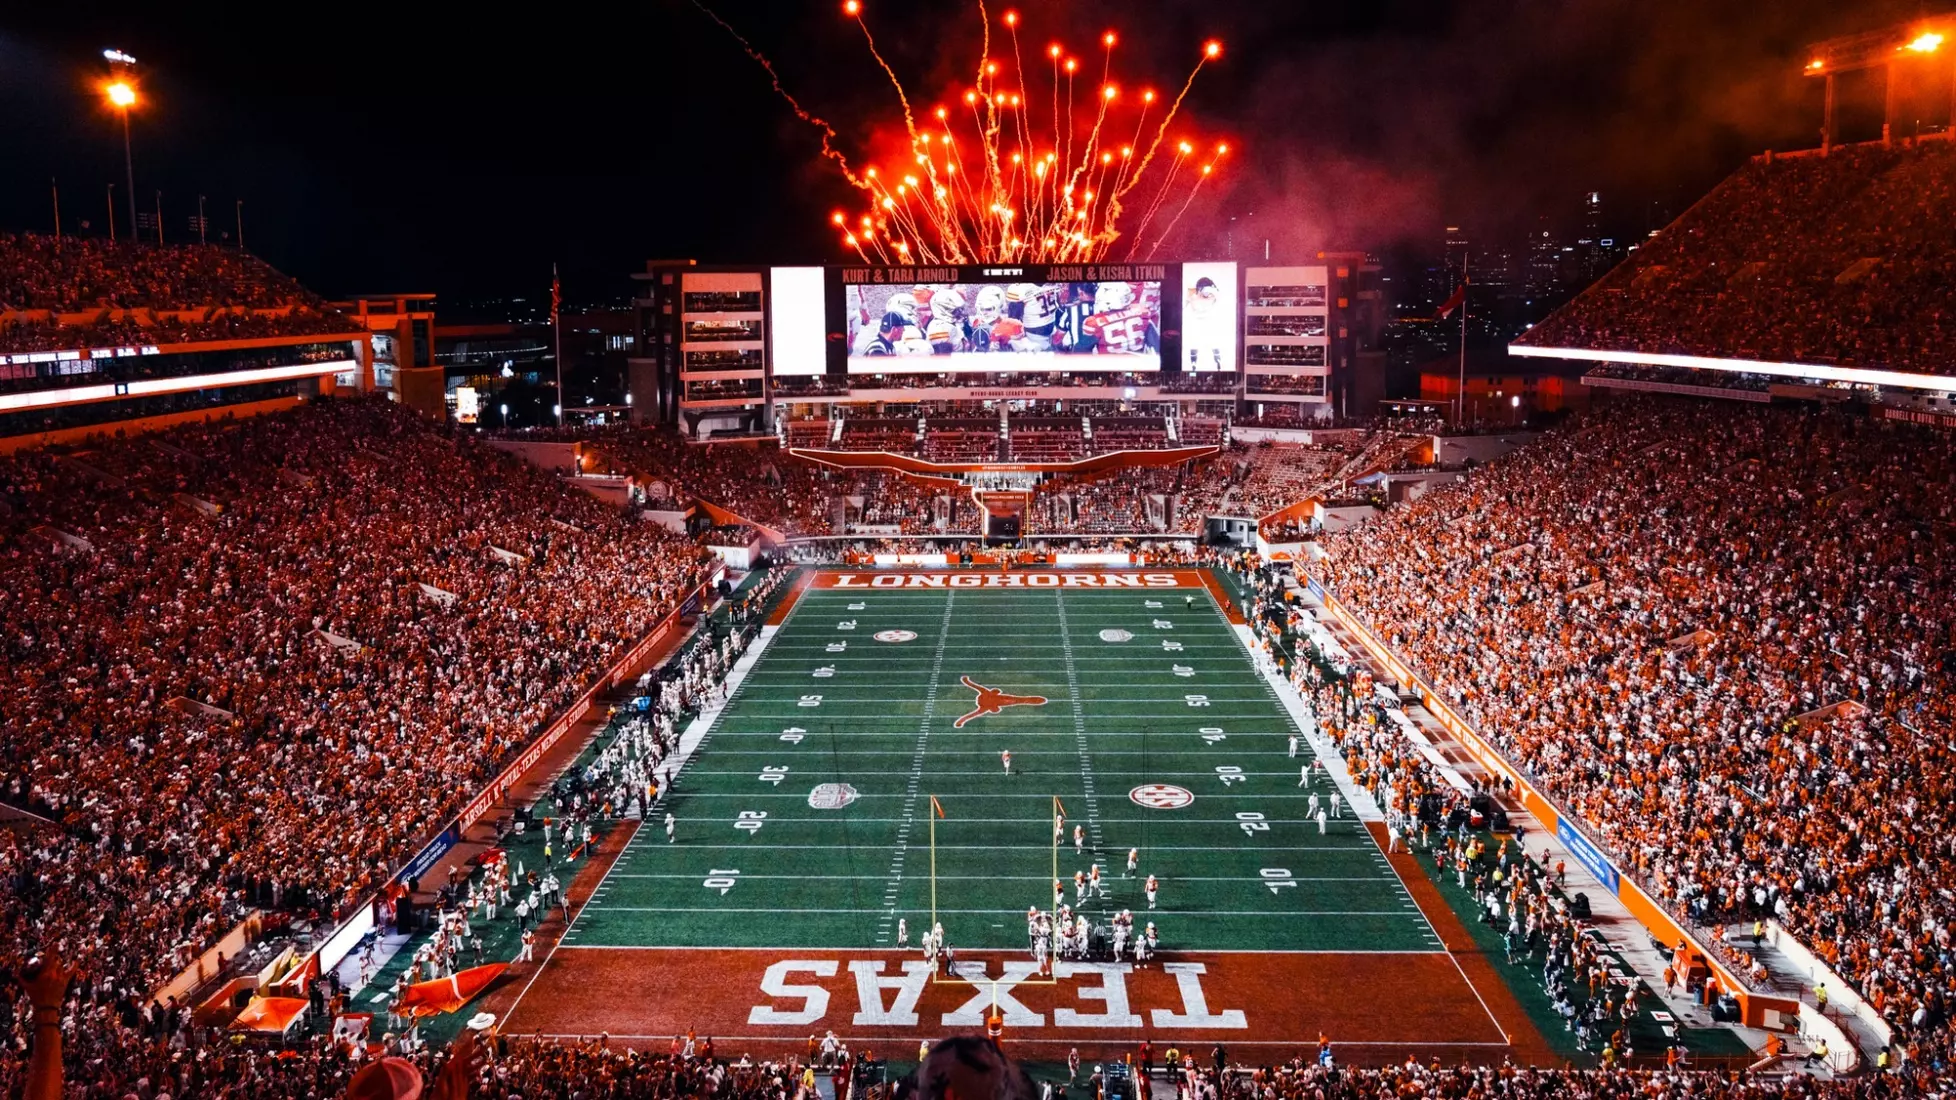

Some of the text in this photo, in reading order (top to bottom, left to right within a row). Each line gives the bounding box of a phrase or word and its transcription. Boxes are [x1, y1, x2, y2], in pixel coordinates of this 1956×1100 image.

[842, 268, 959, 283] KURT & TARA ARNOLD
[1047, 265, 1166, 281] JASON & KISHA ITKIN
[1102, 316, 1145, 354] 56
[832, 573, 1179, 588] LONGHORNS
[797, 695, 823, 707] 50
[1184, 694, 1211, 707] 50
[779, 727, 807, 741] 40
[1198, 727, 1227, 742] 40
[758, 765, 789, 781] 30
[1215, 765, 1247, 782] 30
[733, 810, 768, 829] 20
[1235, 812, 1271, 831] 20
[703, 868, 740, 888] 10
[1259, 868, 1298, 887] 10
[747, 960, 1249, 1029] TEXAS
